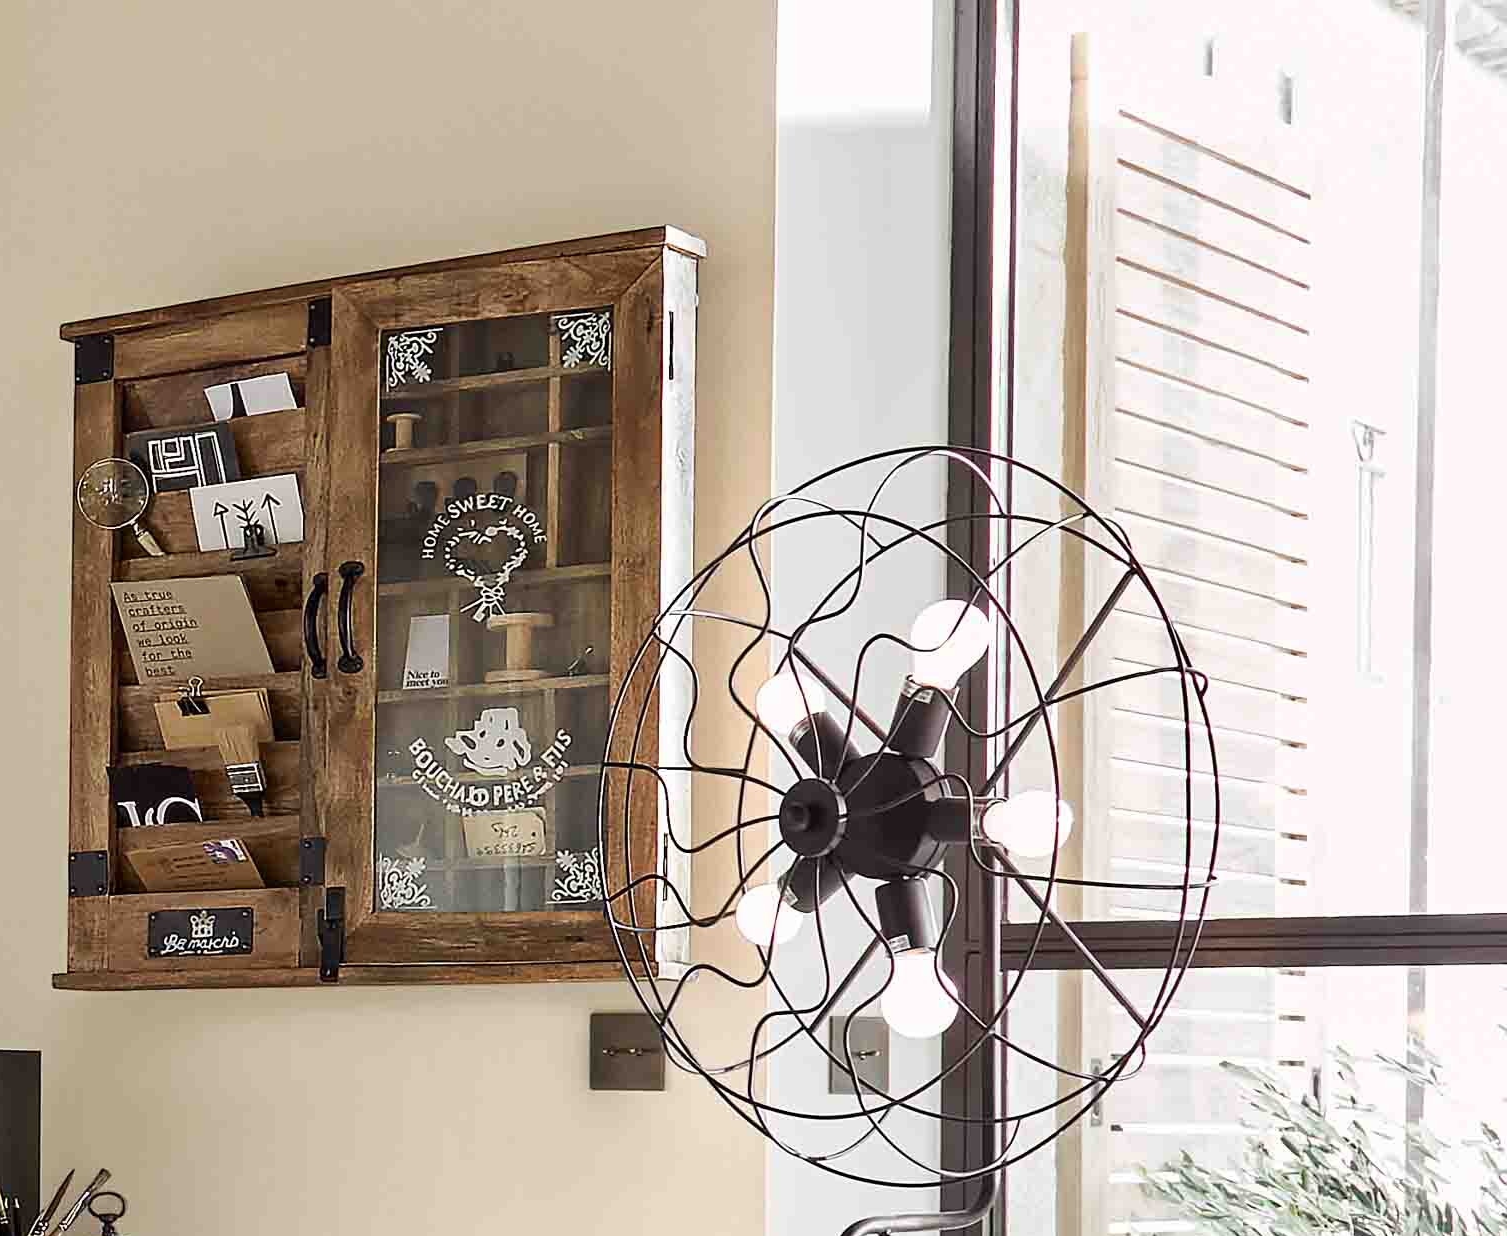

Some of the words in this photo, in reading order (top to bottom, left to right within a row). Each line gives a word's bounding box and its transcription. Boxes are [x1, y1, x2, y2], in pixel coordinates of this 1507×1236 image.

[421, 514, 451, 559] HOME
[447, 494, 513, 519] SWEET
[512, 504, 548, 544] HOME
[144, 591, 172, 602] true
[128, 604, 187, 616] crafters
[132, 620, 147, 632] of
[154, 618, 199, 631] origin
[138, 638, 152, 647] we
[159, 633, 187, 646] look
[142, 652, 163, 662] for
[170, 648, 192, 660] the
[145, 666, 175, 677] best
[407, 670, 429, 679] Nice
[431, 670, 440, 678] to
[432, 680, 448, 688] you
[493, 775, 534, 805] PERE
